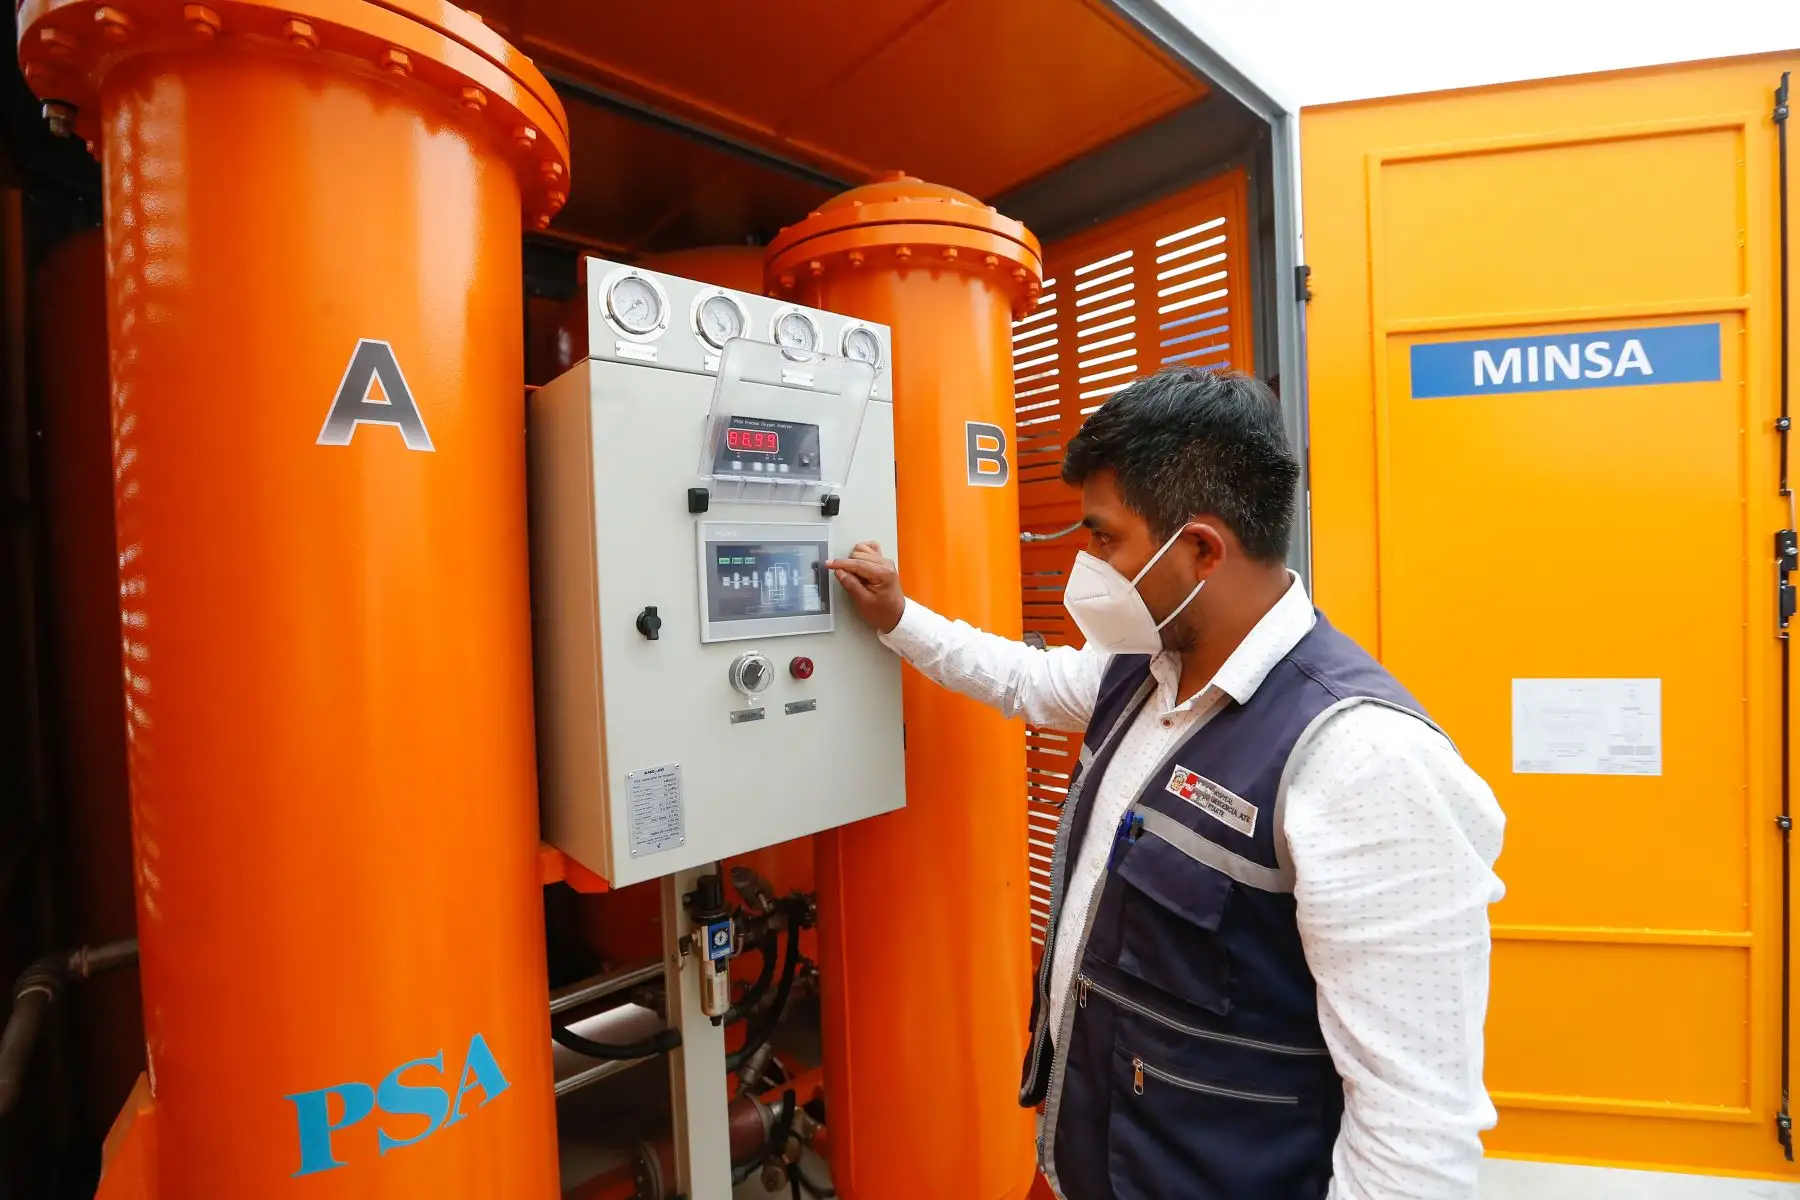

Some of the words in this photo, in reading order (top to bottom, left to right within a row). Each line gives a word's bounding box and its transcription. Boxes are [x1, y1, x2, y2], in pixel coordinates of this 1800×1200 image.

[316, 338, 436, 452] A
[1472, 338, 1654, 387] MINSA
[966, 421, 1009, 487] B
[283, 1032, 512, 1178] PSA
